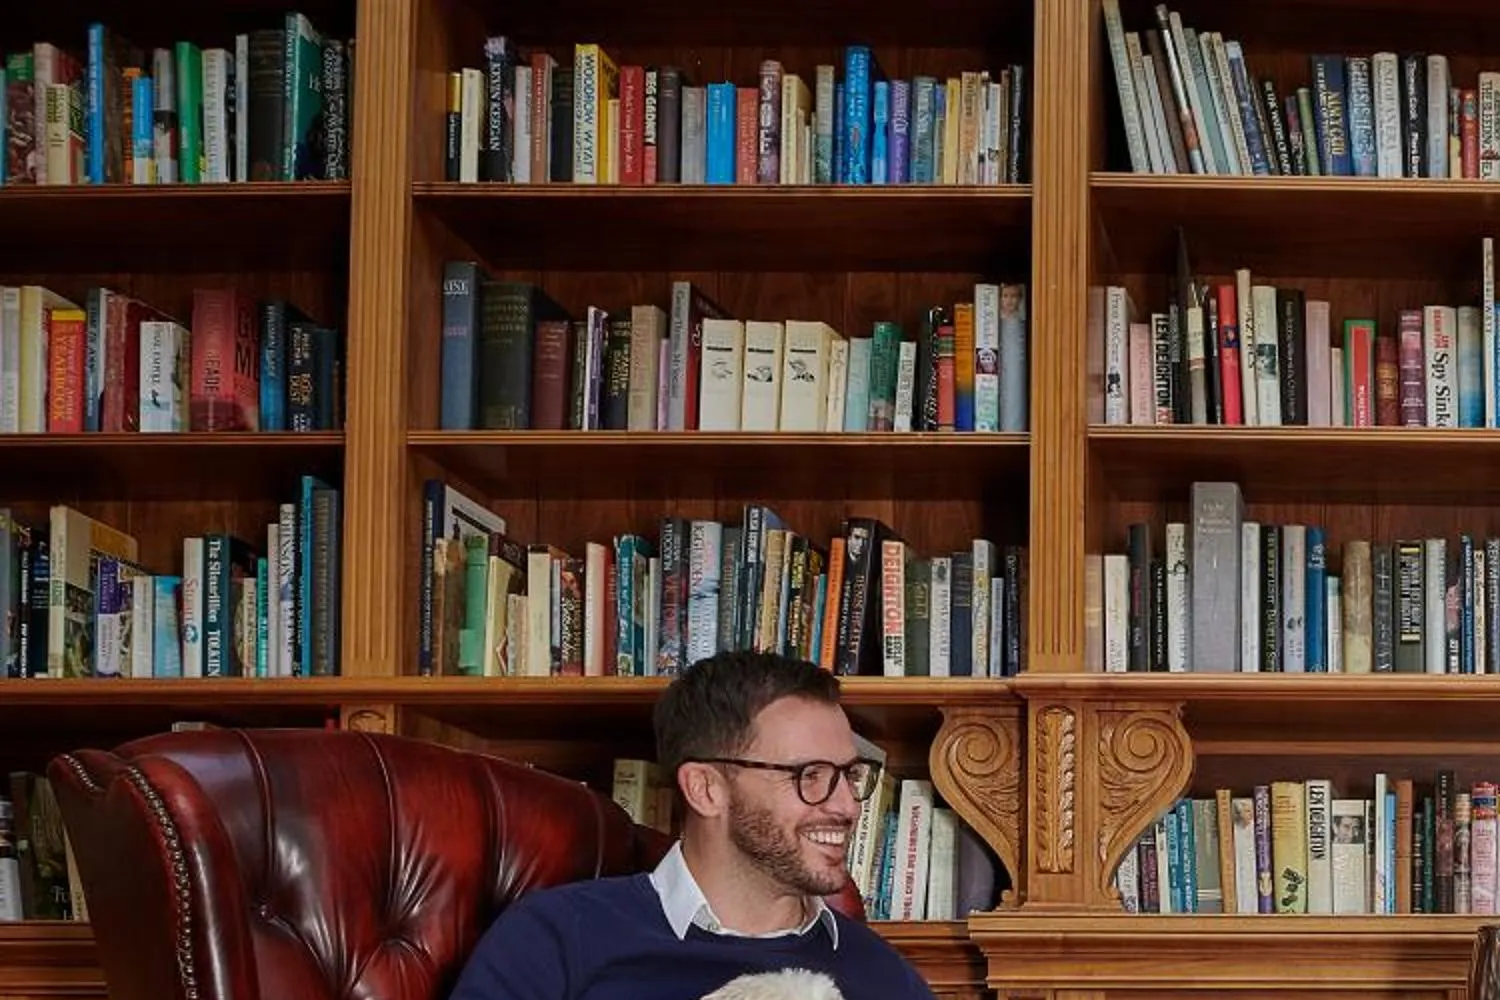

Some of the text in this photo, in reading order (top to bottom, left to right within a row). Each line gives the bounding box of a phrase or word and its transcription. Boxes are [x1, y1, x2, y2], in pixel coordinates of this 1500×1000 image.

[490, 62, 501, 151] KEVIN KEEGAN
[583, 54, 594, 176] WOODROW WYATT
[644, 71, 656, 95] REG
[1409, 97, 1420, 121] Cook
[1156, 317, 1170, 341] LEN
[53, 334, 66, 421] YEARBOOK
[1156, 343, 1170, 407] DEIGHTON
[1432, 352, 1450, 425] Spy Sink
[208, 540, 221, 677] The Silmarillion TOLKIEN
[884, 543, 901, 634] DEIGHTON
[1310, 785, 1326, 860] LEN DEIGHTON
